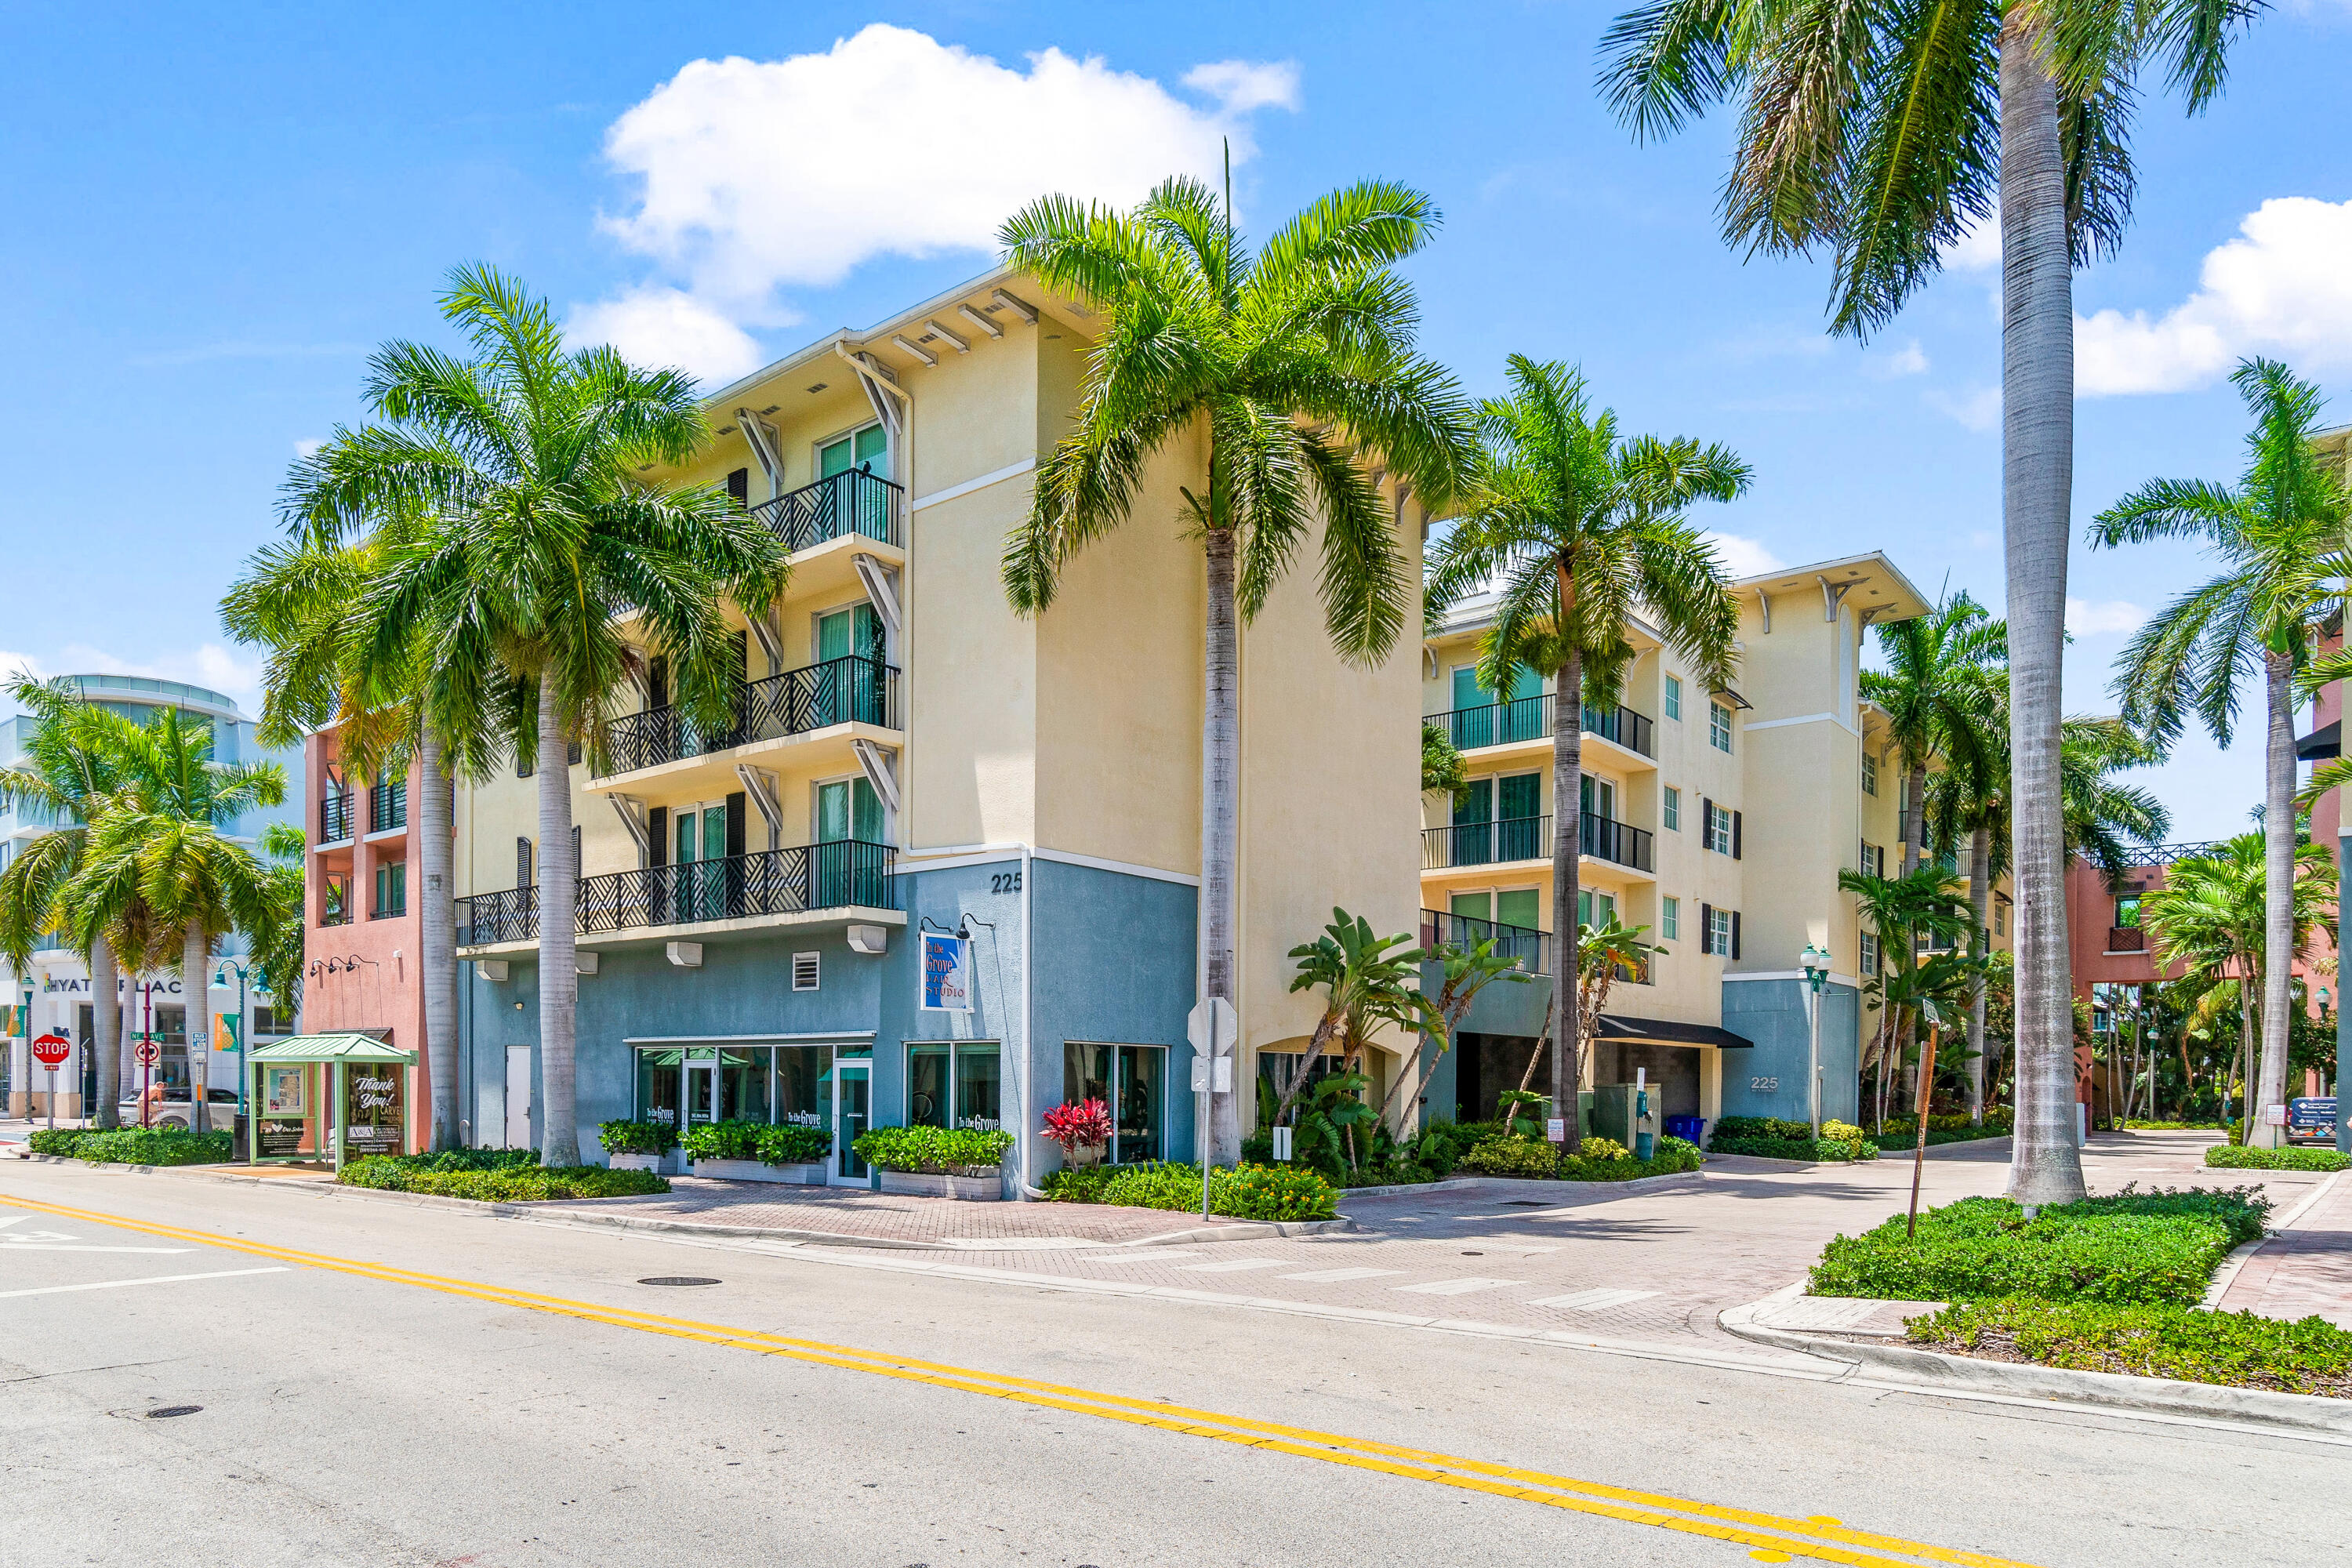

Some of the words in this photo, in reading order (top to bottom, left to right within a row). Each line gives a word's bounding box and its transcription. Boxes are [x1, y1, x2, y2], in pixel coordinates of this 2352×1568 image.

[991, 872, 1022, 894] 225
[926, 942, 932, 953] In
[934, 942, 944, 953] the
[926, 953, 953, 973] Grove
[50, 978, 91, 993] HYAT
[118, 979, 182, 993] PLAC
[926, 974, 954, 988] HAIR
[926, 986, 965, 997] STUDIO
[35, 1042, 69, 1054] STOP
[355, 1076, 396, 1091] Thank
[1751, 1076, 1779, 1089] 225
[360, 1093, 395, 1109] You!
[658, 1105, 674, 1120] Grove
[800, 1109, 821, 1125] Grove
[959, 1116, 965, 1127] In
[965, 1117, 975, 1127] the
[975, 1113, 1000, 1131] Grove
[349, 1127, 373, 1137] A&A
